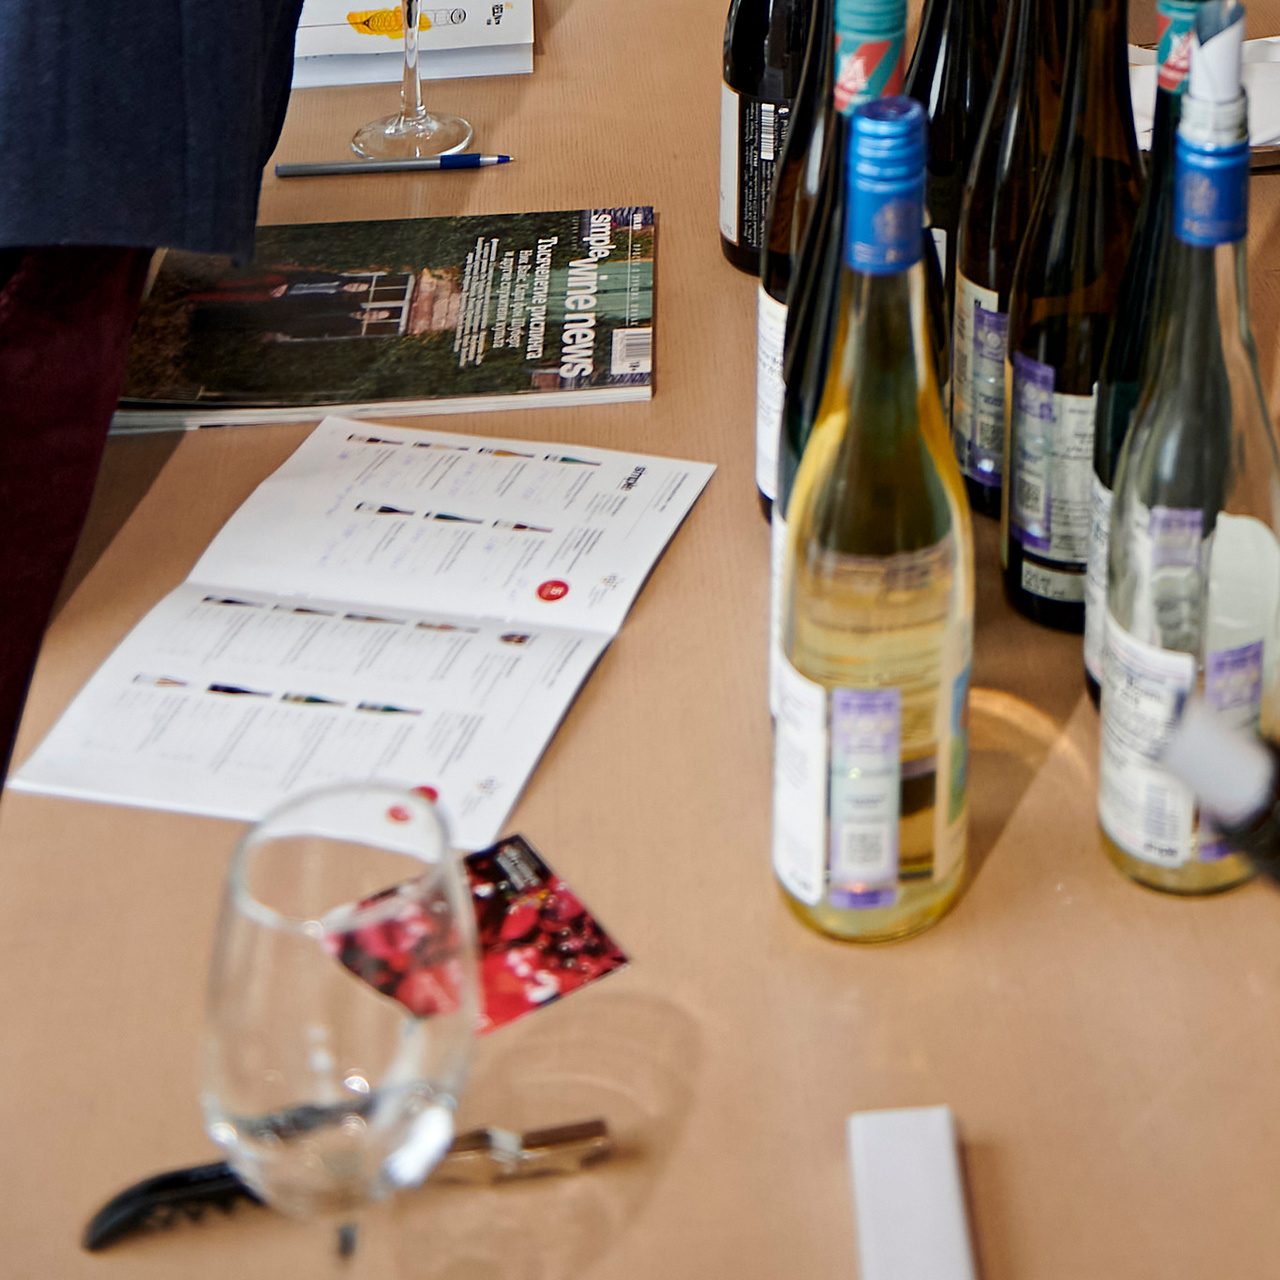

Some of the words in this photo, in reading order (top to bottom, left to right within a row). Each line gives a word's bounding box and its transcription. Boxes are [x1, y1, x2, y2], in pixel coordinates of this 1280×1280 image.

[582, 214, 617, 258] simple
[532, 236, 557, 304] Тысячелетие
[564, 258, 607, 310] wine
[525, 306, 547, 360] рислинга
[559, 313, 596, 378] news
